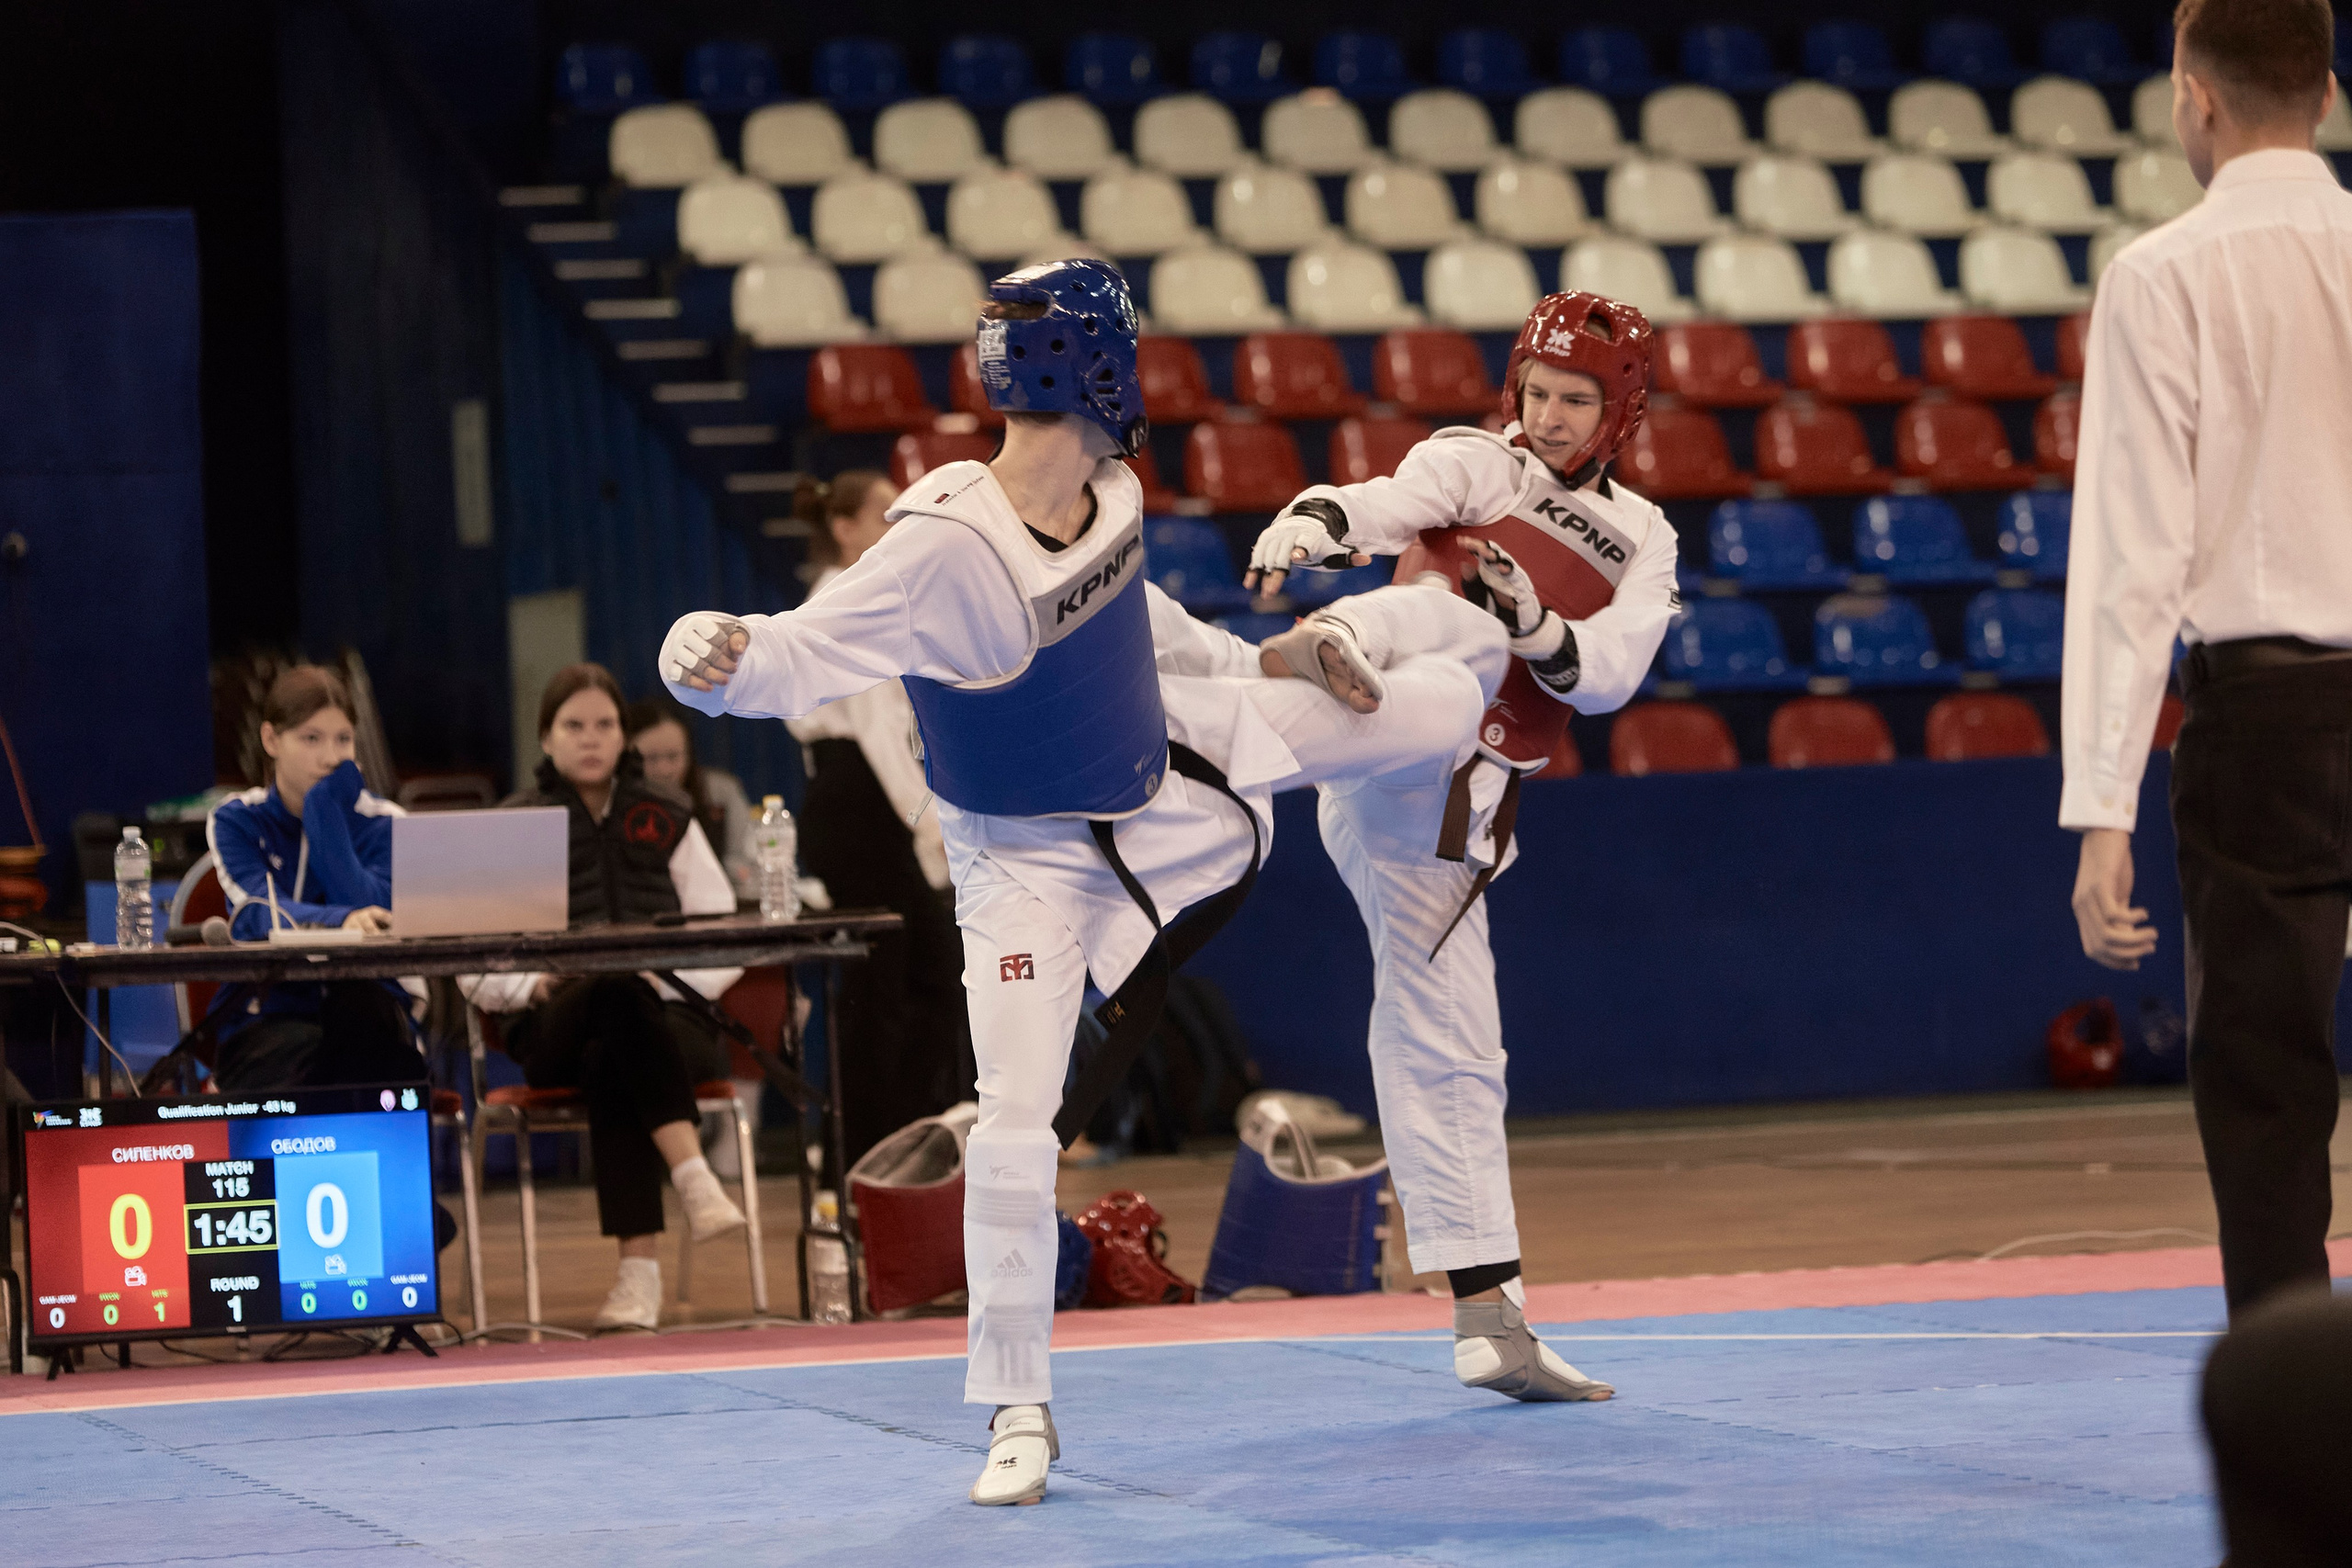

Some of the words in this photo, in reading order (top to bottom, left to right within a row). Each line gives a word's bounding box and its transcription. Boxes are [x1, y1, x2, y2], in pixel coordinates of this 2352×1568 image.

[1532, 498, 1625, 564] KPNP
[1057, 533, 1139, 626] KPNP
[1489, 728, 1500, 741] 3
[157, 1105, 224, 1119] Qualification
[224, 1102, 259, 1115] Junior
[280, 1100, 297, 1114] kg
[111, 1144, 195, 1164] СИЛЕНКОВ
[271, 1136, 336, 1155] ОБОДОВ
[205, 1160, 254, 1177] MATCH
[212, 1177, 250, 1199] 115
[306, 1182, 348, 1248] 0
[109, 1193, 153, 1260] 0
[194, 1210, 273, 1247] 1:45
[209, 1276, 260, 1292] ROUND
[991, 1268, 1034, 1278] adidas
[300, 1292, 317, 1314] 0
[352, 1289, 368, 1311] 0
[401, 1286, 418, 1308] 0
[50, 1307, 65, 1329] 0
[103, 1304, 119, 1325] 0
[153, 1302, 166, 1323] 1
[227, 1295, 242, 1323] 1
